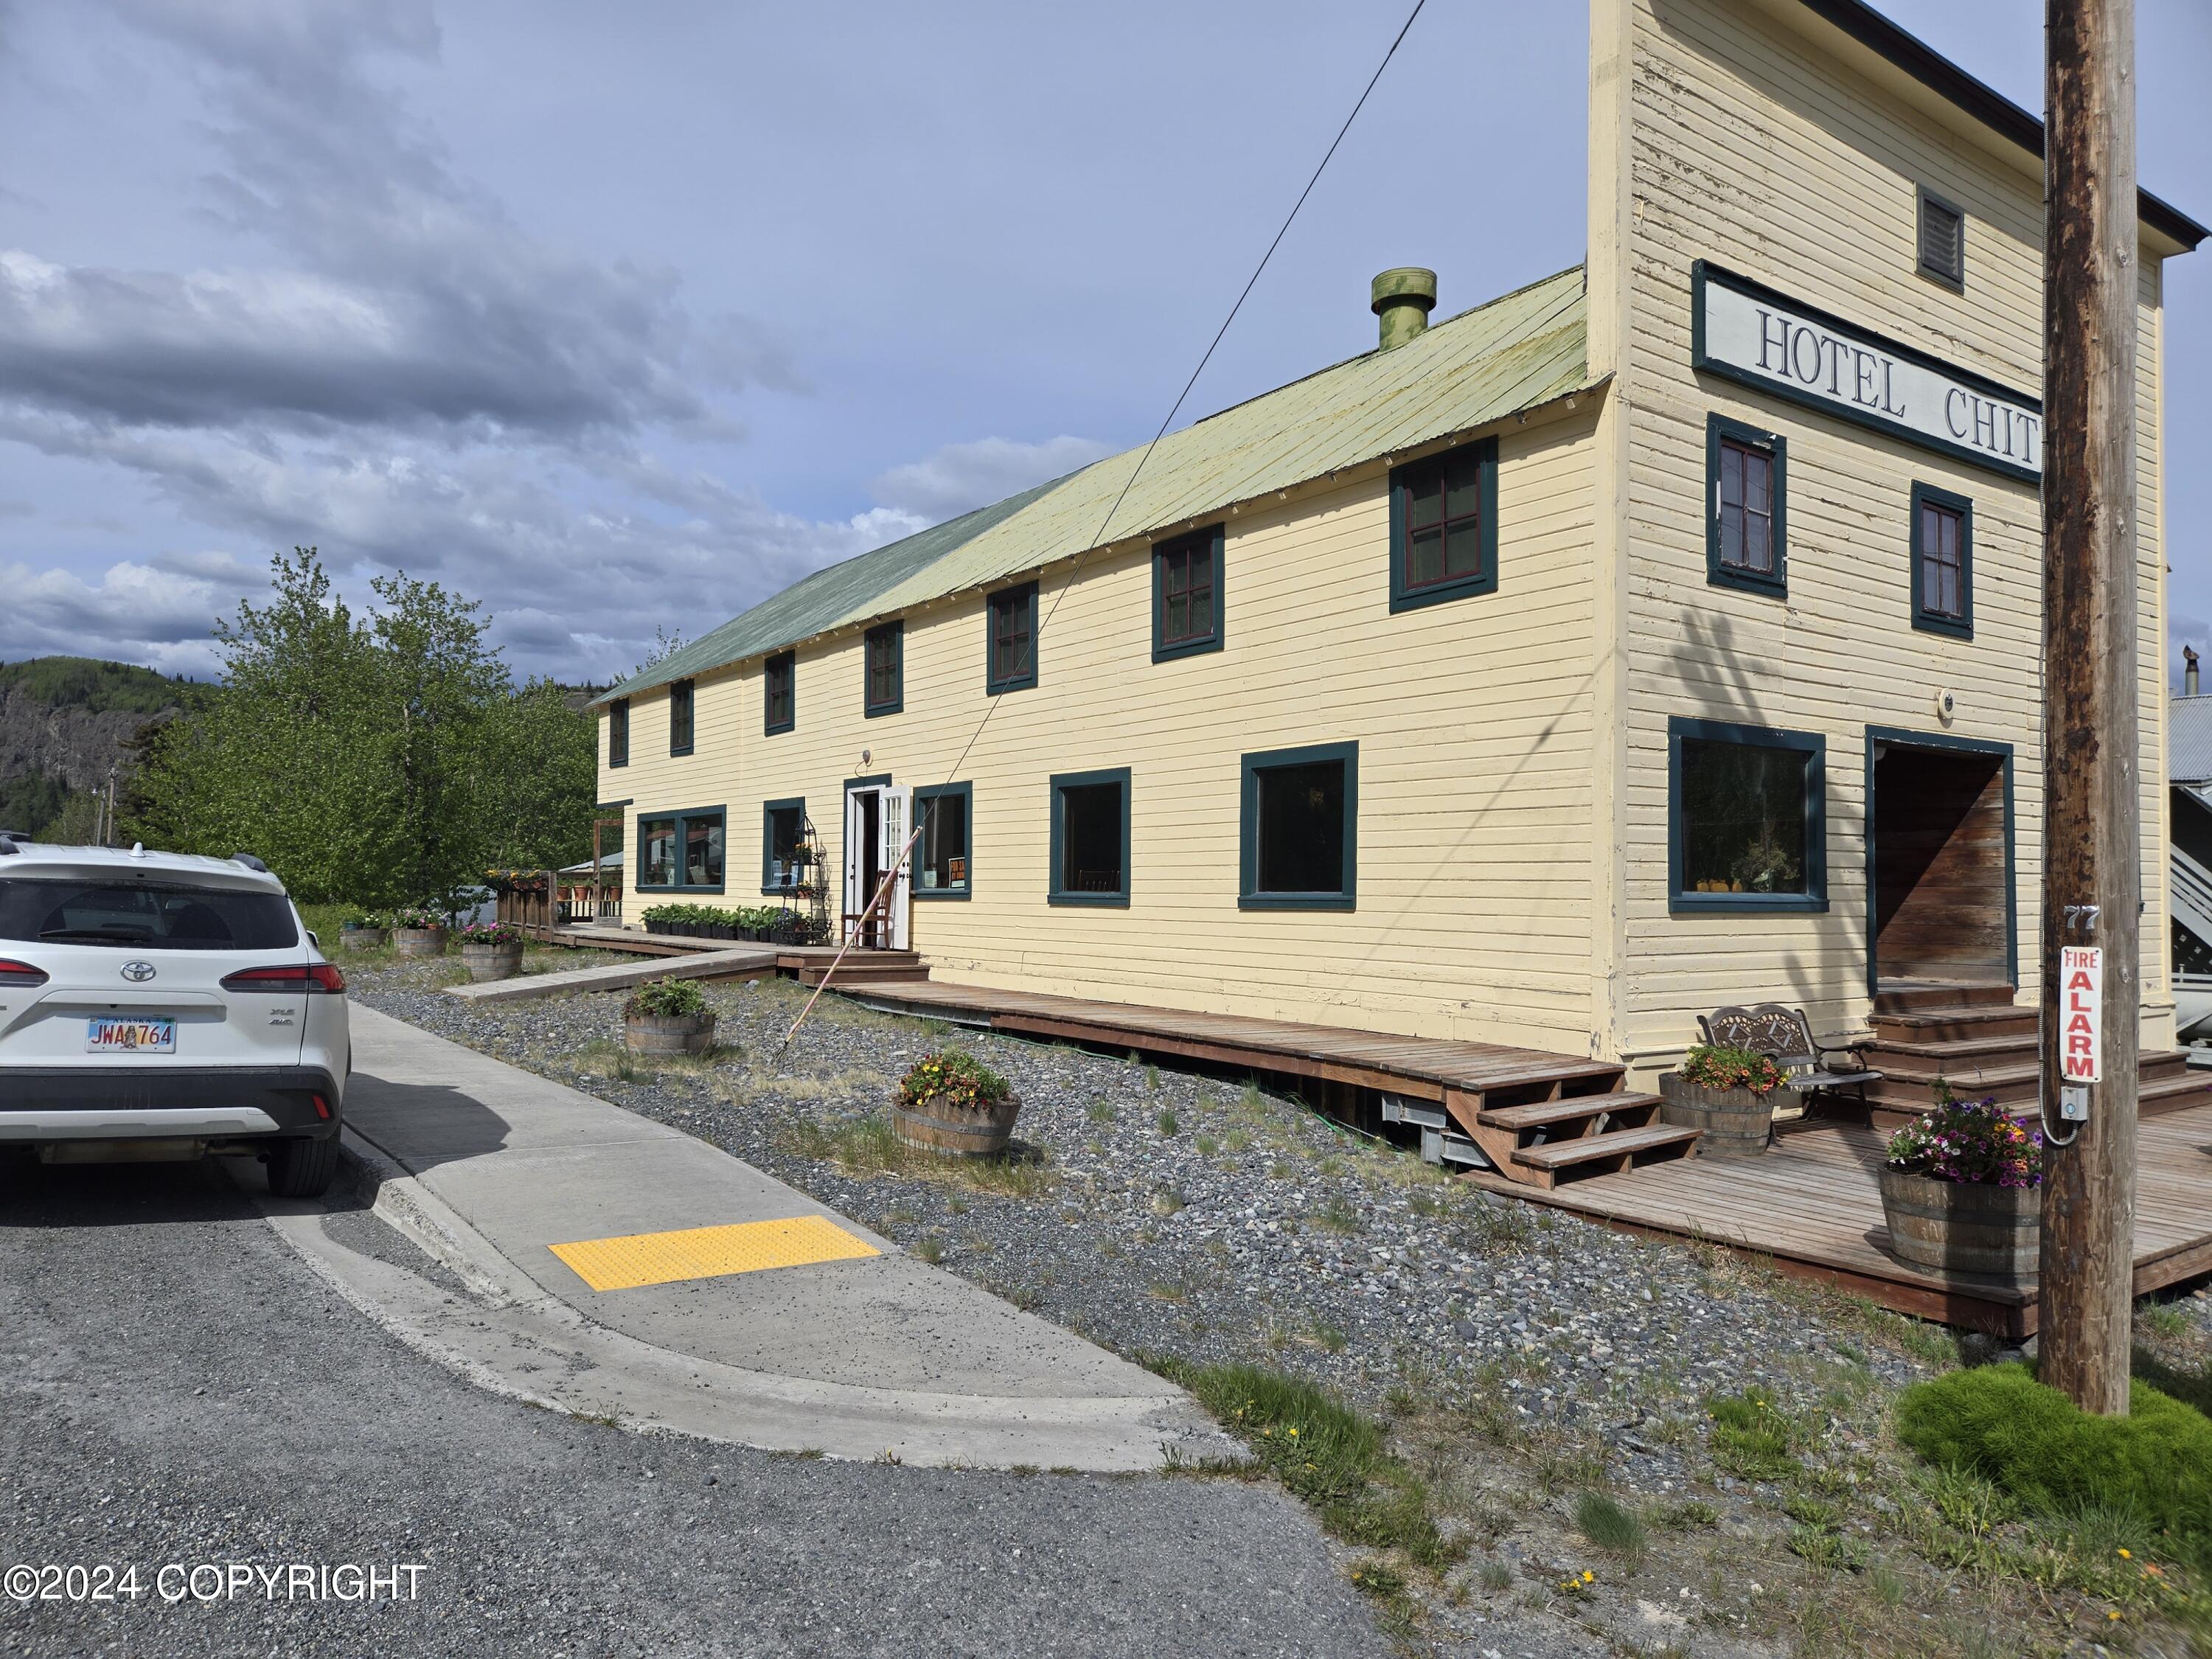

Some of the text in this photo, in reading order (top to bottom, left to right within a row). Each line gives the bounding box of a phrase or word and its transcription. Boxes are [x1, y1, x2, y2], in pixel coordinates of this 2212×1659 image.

[1754, 308, 2039, 465] HOTEL CHIT
[2063, 905, 2101, 930] 77
[2065, 950, 2098, 969] FIRE
[91, 1024, 172, 1044] JWA 764
[2067, 971, 2094, 1077] ALARM
